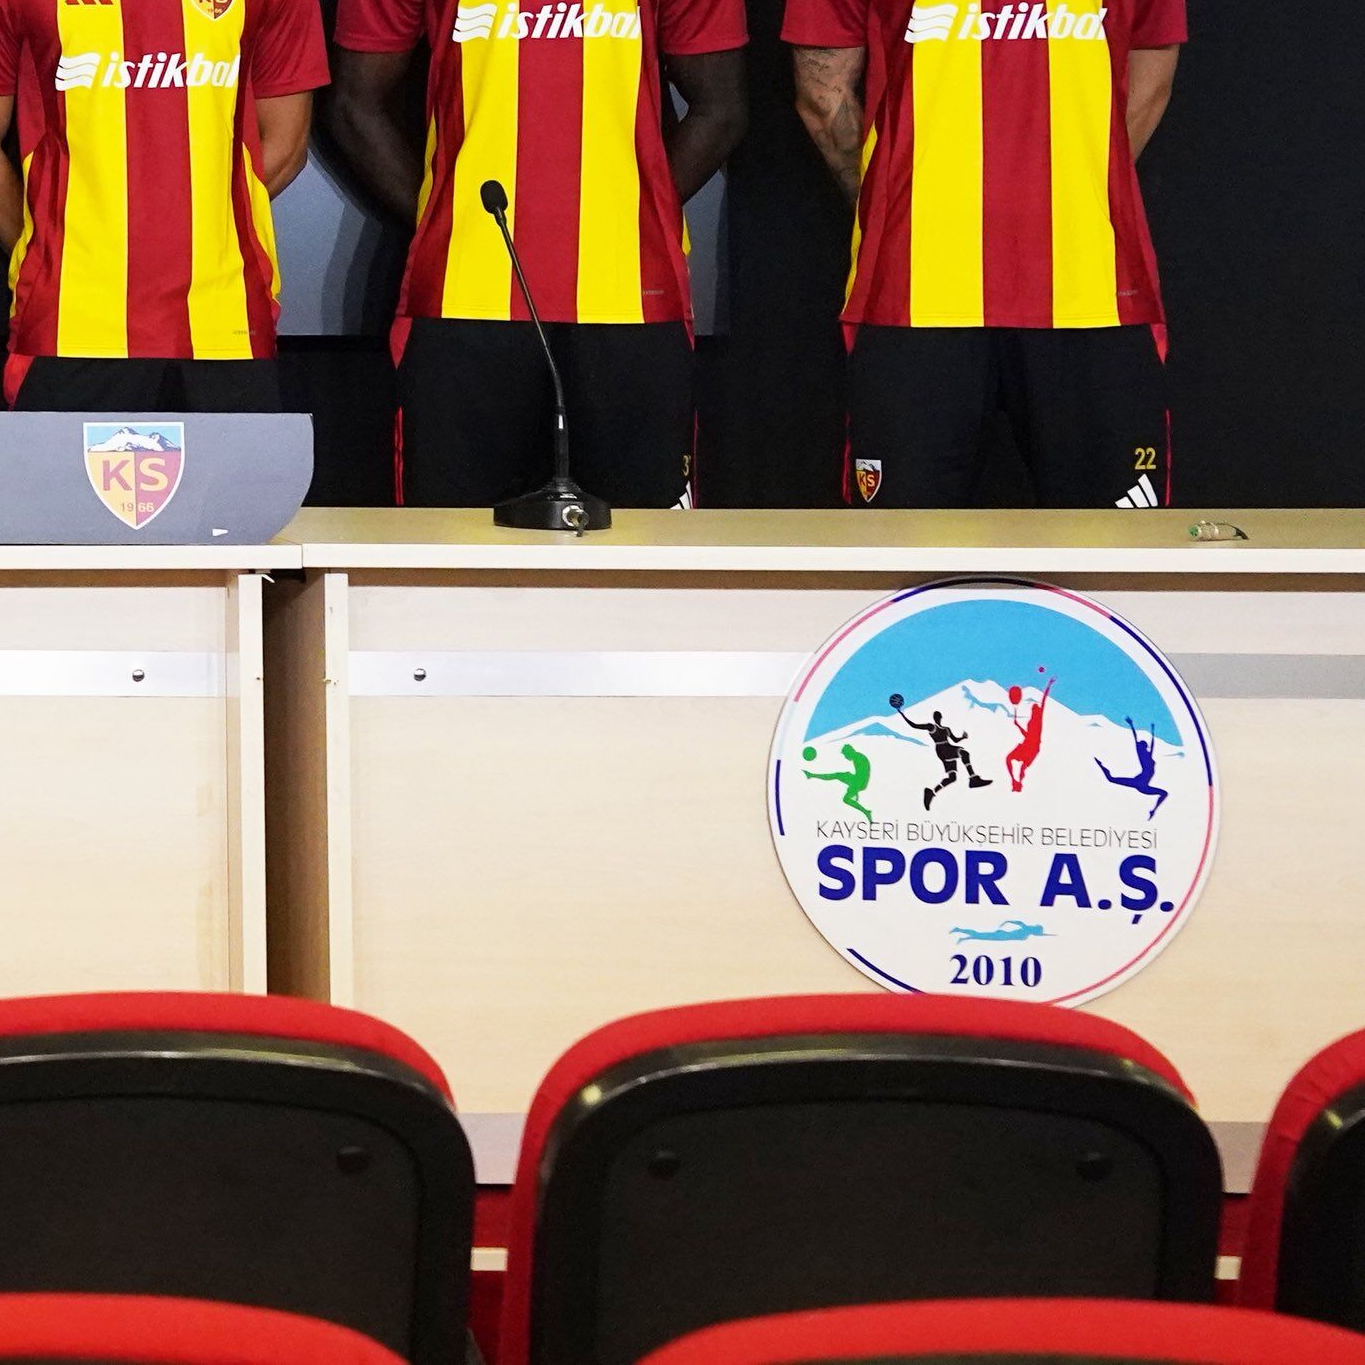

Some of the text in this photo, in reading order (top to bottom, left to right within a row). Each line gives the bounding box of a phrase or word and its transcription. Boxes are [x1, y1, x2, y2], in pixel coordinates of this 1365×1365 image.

[496, 2, 640, 39] istikbal
[957, 2, 1106, 40] istikbal
[101, 52, 240, 88] istikbal
[102, 457, 168, 492] KS
[1134, 447, 1156, 469] 22
[859, 473, 875, 487] KS
[121, 501, 155, 513] 1966
[816, 819, 1158, 849] KAYSERİ BÜYÜKŞEHİR BELEDİYESİ
[816, 845, 1176, 925] SPOR A.Ş.
[948, 955, 1043, 988] 2010
